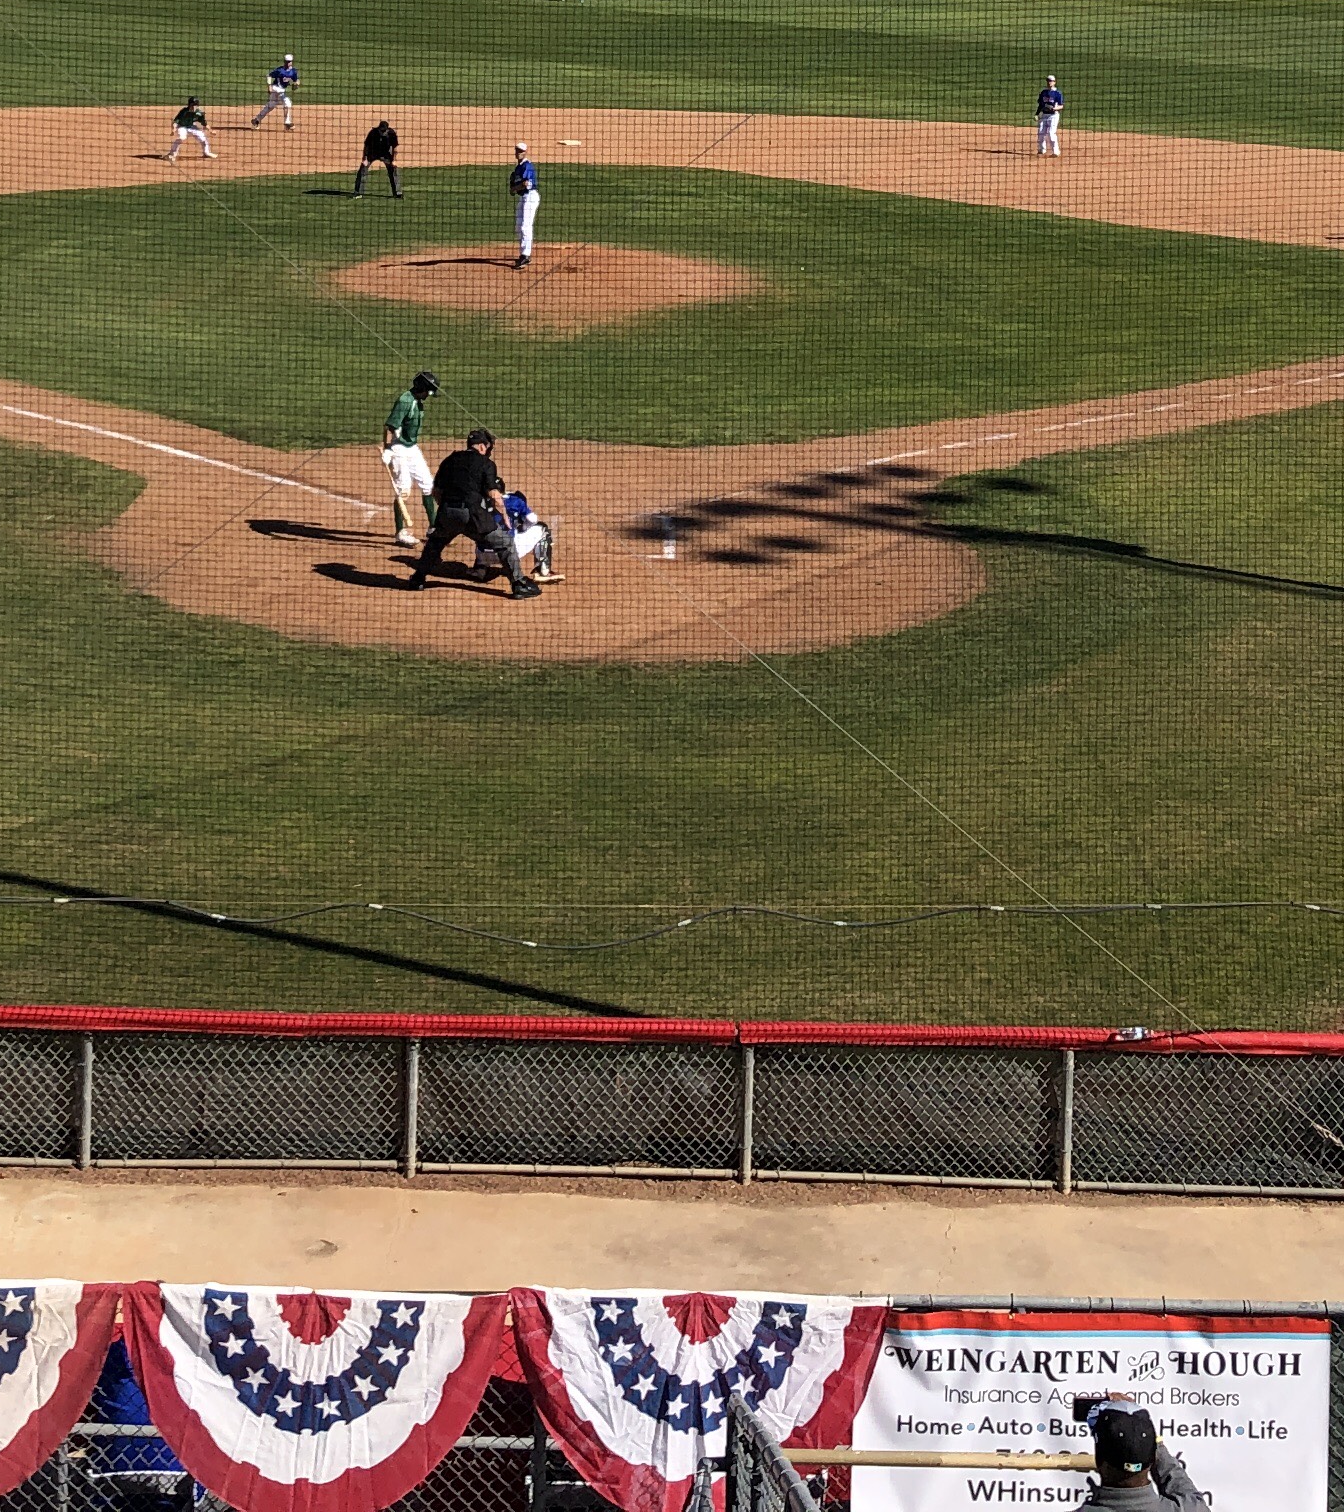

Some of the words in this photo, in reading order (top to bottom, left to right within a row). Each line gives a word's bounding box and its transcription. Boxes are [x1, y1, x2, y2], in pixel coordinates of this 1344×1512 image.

[884, 1345, 1120, 1382] WEINGARTEN
[1127, 1351, 1165, 1381] and
[1168, 1350, 1303, 1378] HOUGH
[944, 1385, 1042, 1405] Insurance
[1046, 1386, 1109, 1408] Agent
[1170, 1387, 1240, 1407] Brokers
[896, 1415, 963, 1435] Home
[978, 1416, 1033, 1436] Auto
[1159, 1418, 1232, 1438] Health
[1247, 1419, 1288, 1440] Life
